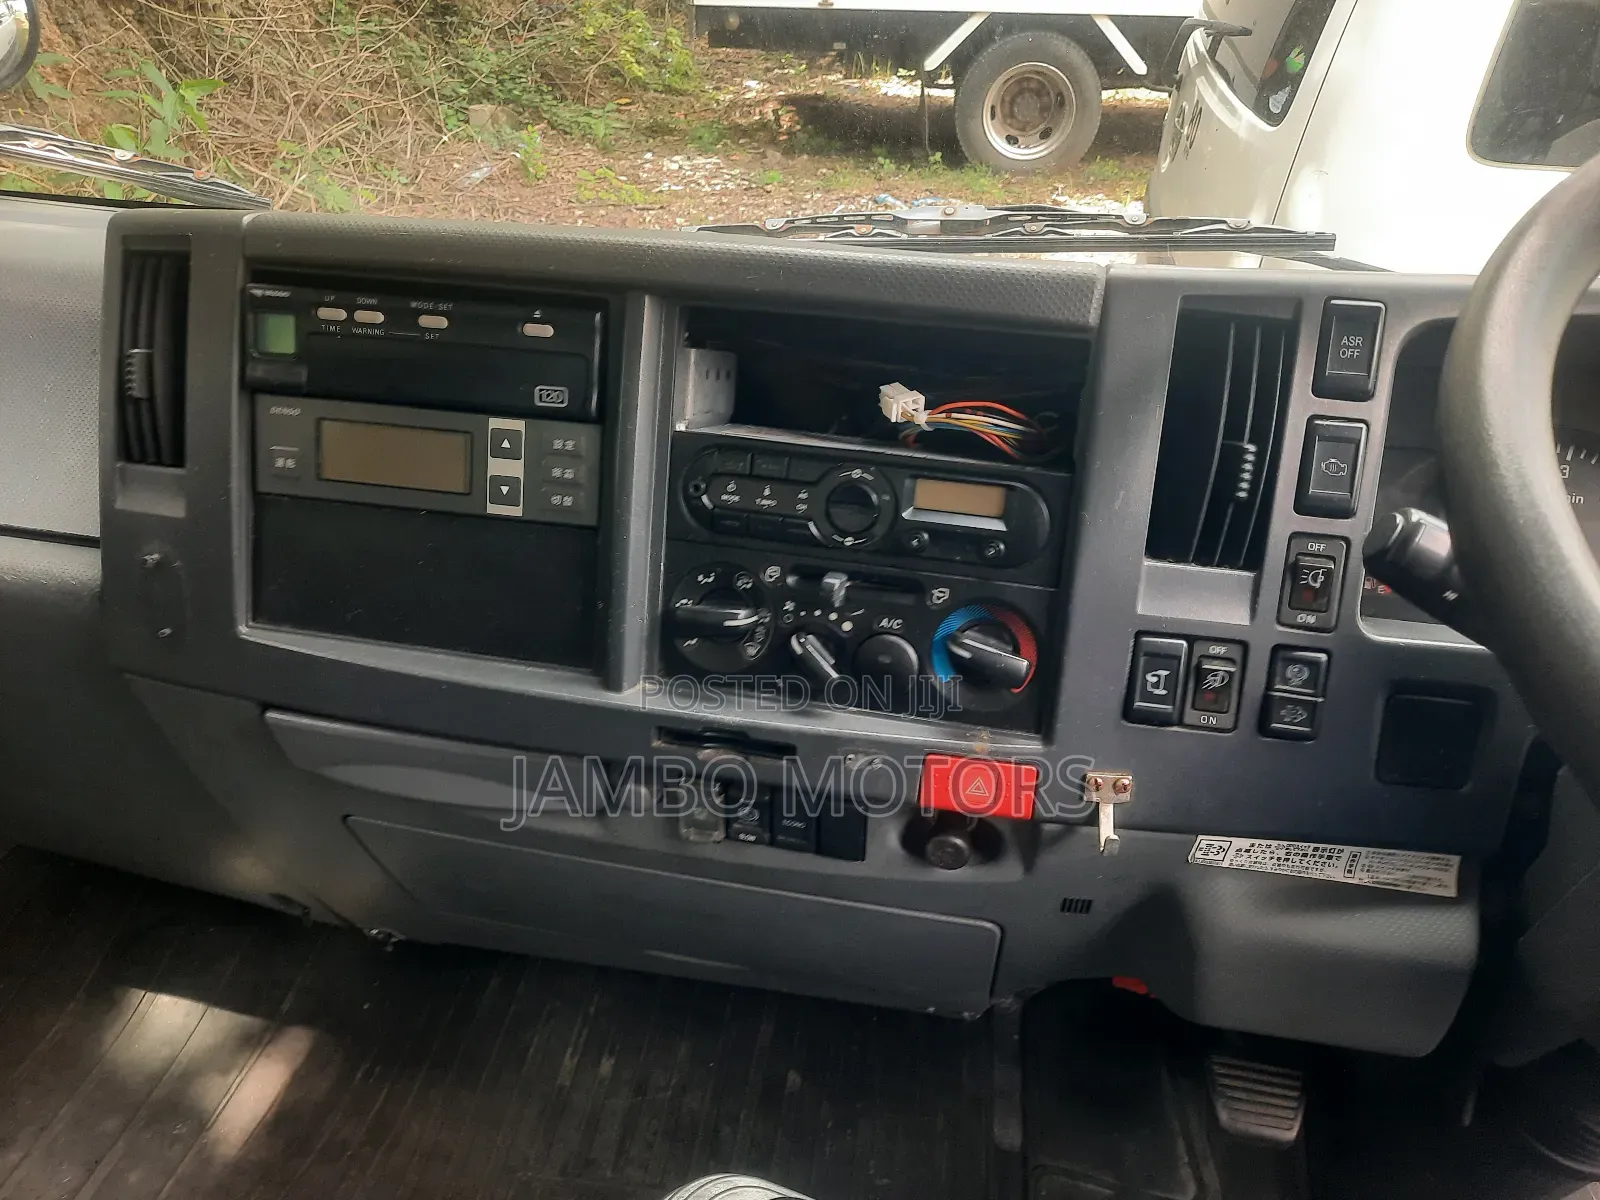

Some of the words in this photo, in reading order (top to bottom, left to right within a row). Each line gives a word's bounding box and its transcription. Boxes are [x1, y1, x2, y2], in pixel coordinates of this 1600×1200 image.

[356, 297, 378, 305] DOWN
[410, 301, 434, 310] MODE
[321, 325, 341, 333] TIME
[351, 327, 385, 336] WARNING
[1340, 335, 1364, 347] ASR
[1339, 348, 1361, 359] OFF
[1307, 542, 1327, 552] OFF
[878, 617, 903, 630] A/C
[1296, 613, 1317, 624] ON
[1208, 645, 1229, 655] OFF
[1200, 715, 1217, 725] ON
